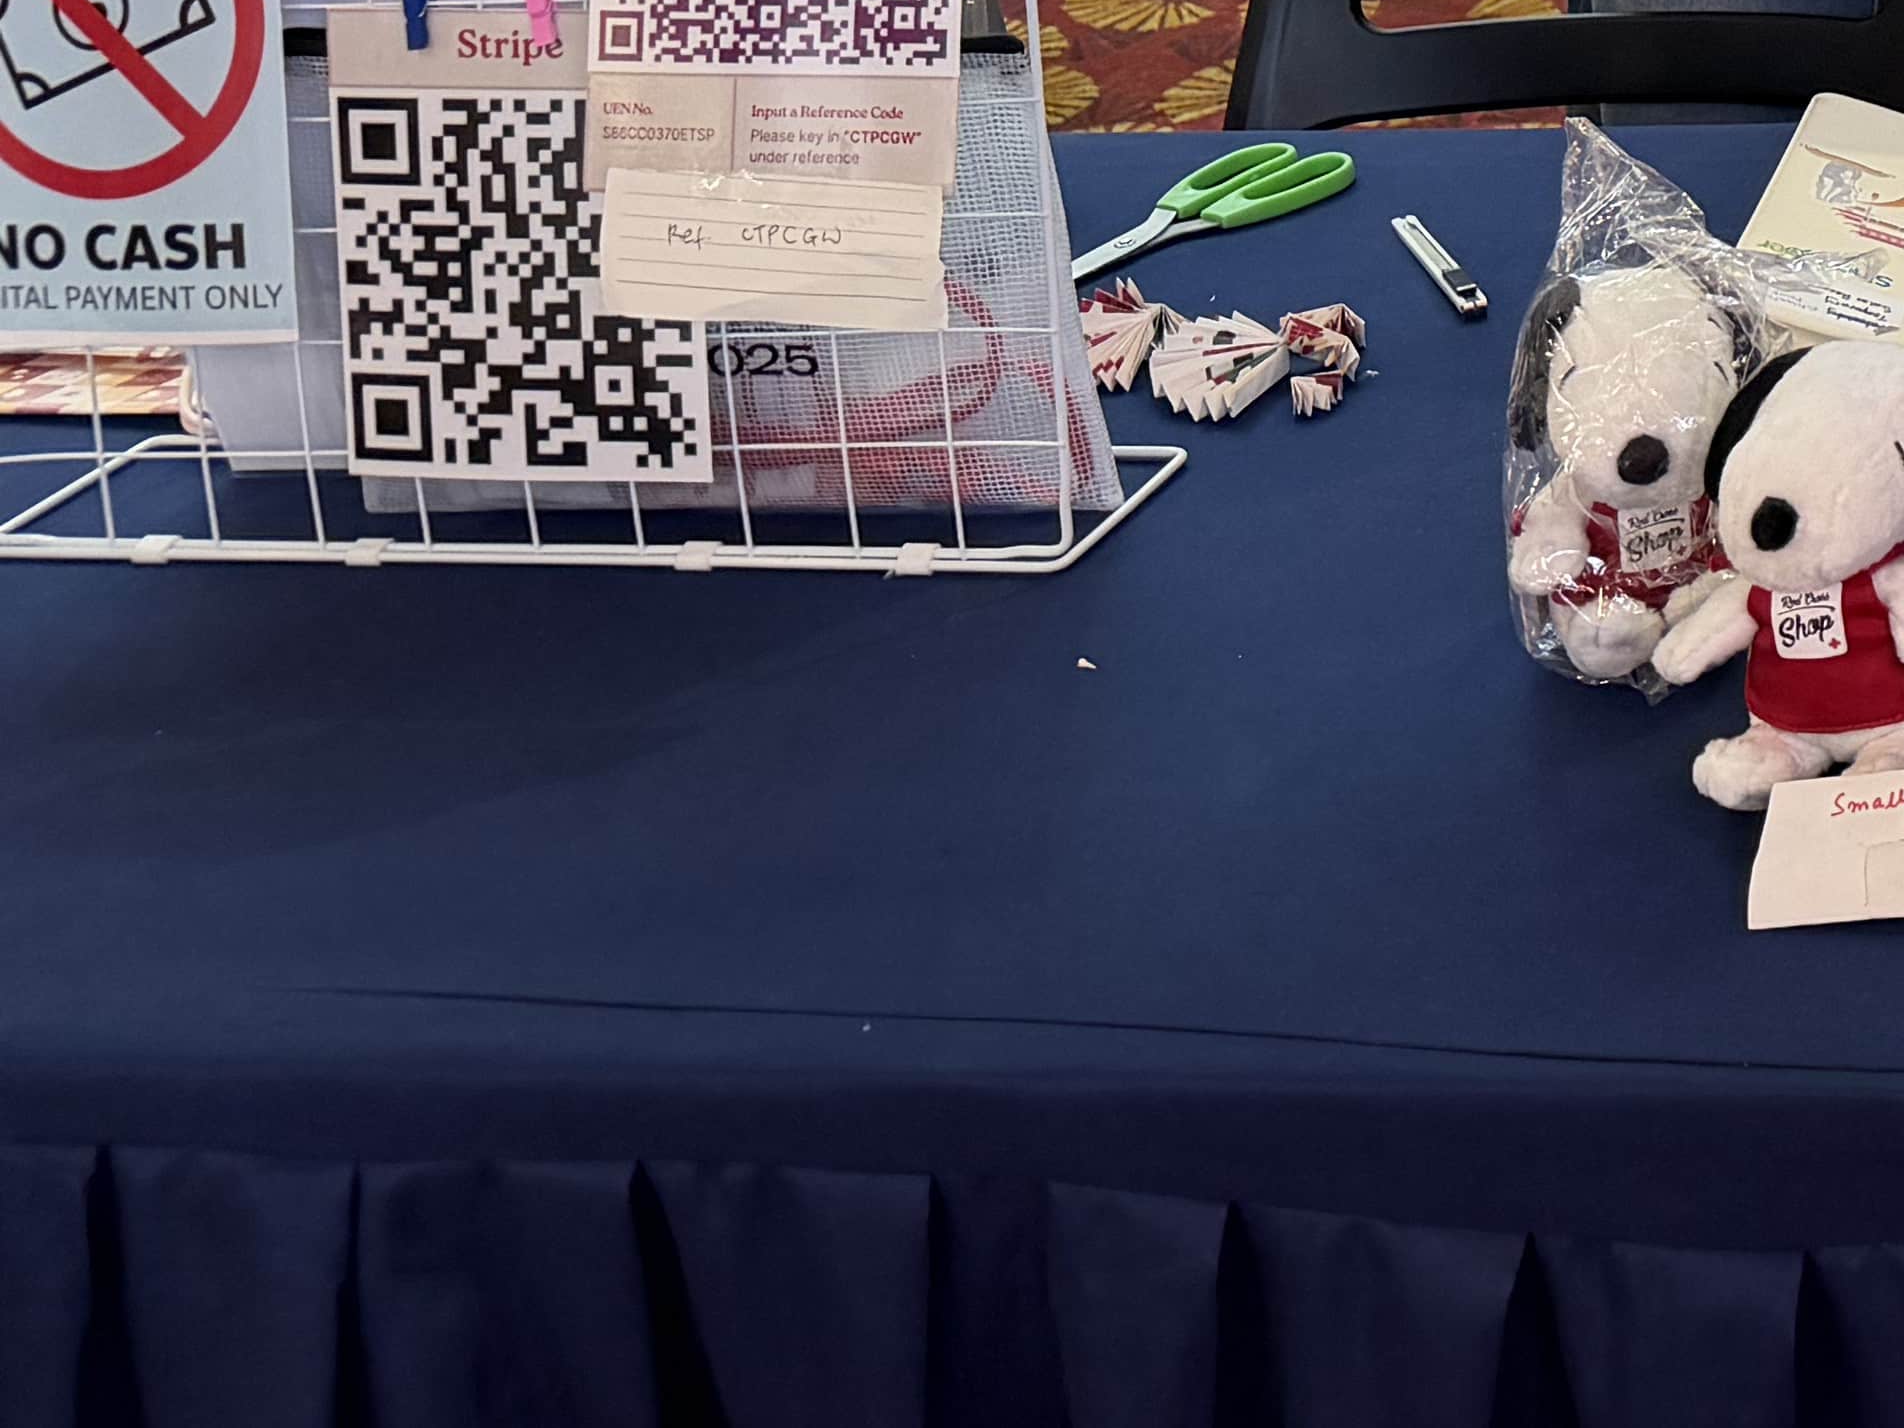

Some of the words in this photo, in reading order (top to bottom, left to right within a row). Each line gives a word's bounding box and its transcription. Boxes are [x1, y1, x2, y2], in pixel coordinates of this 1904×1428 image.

[456, 29, 564, 65] Stripe
[751, 104, 788, 122] Input
[800, 105, 867, 120] Reference
[870, 106, 904, 121] Code
[750, 129, 796, 144] Please
[797, 129, 823, 147] key
[826, 129, 840, 143] in
[749, 150, 789, 165] under
[791, 149, 860, 165] reference
[0, 223, 65, 271] NO
[86, 223, 246, 271] CASH
[66, 284, 196, 311] PAYMENT
[205, 283, 284, 311] ONLY
[1626, 525, 1685, 563] Shop
[1778, 611, 1835, 647] Shop
